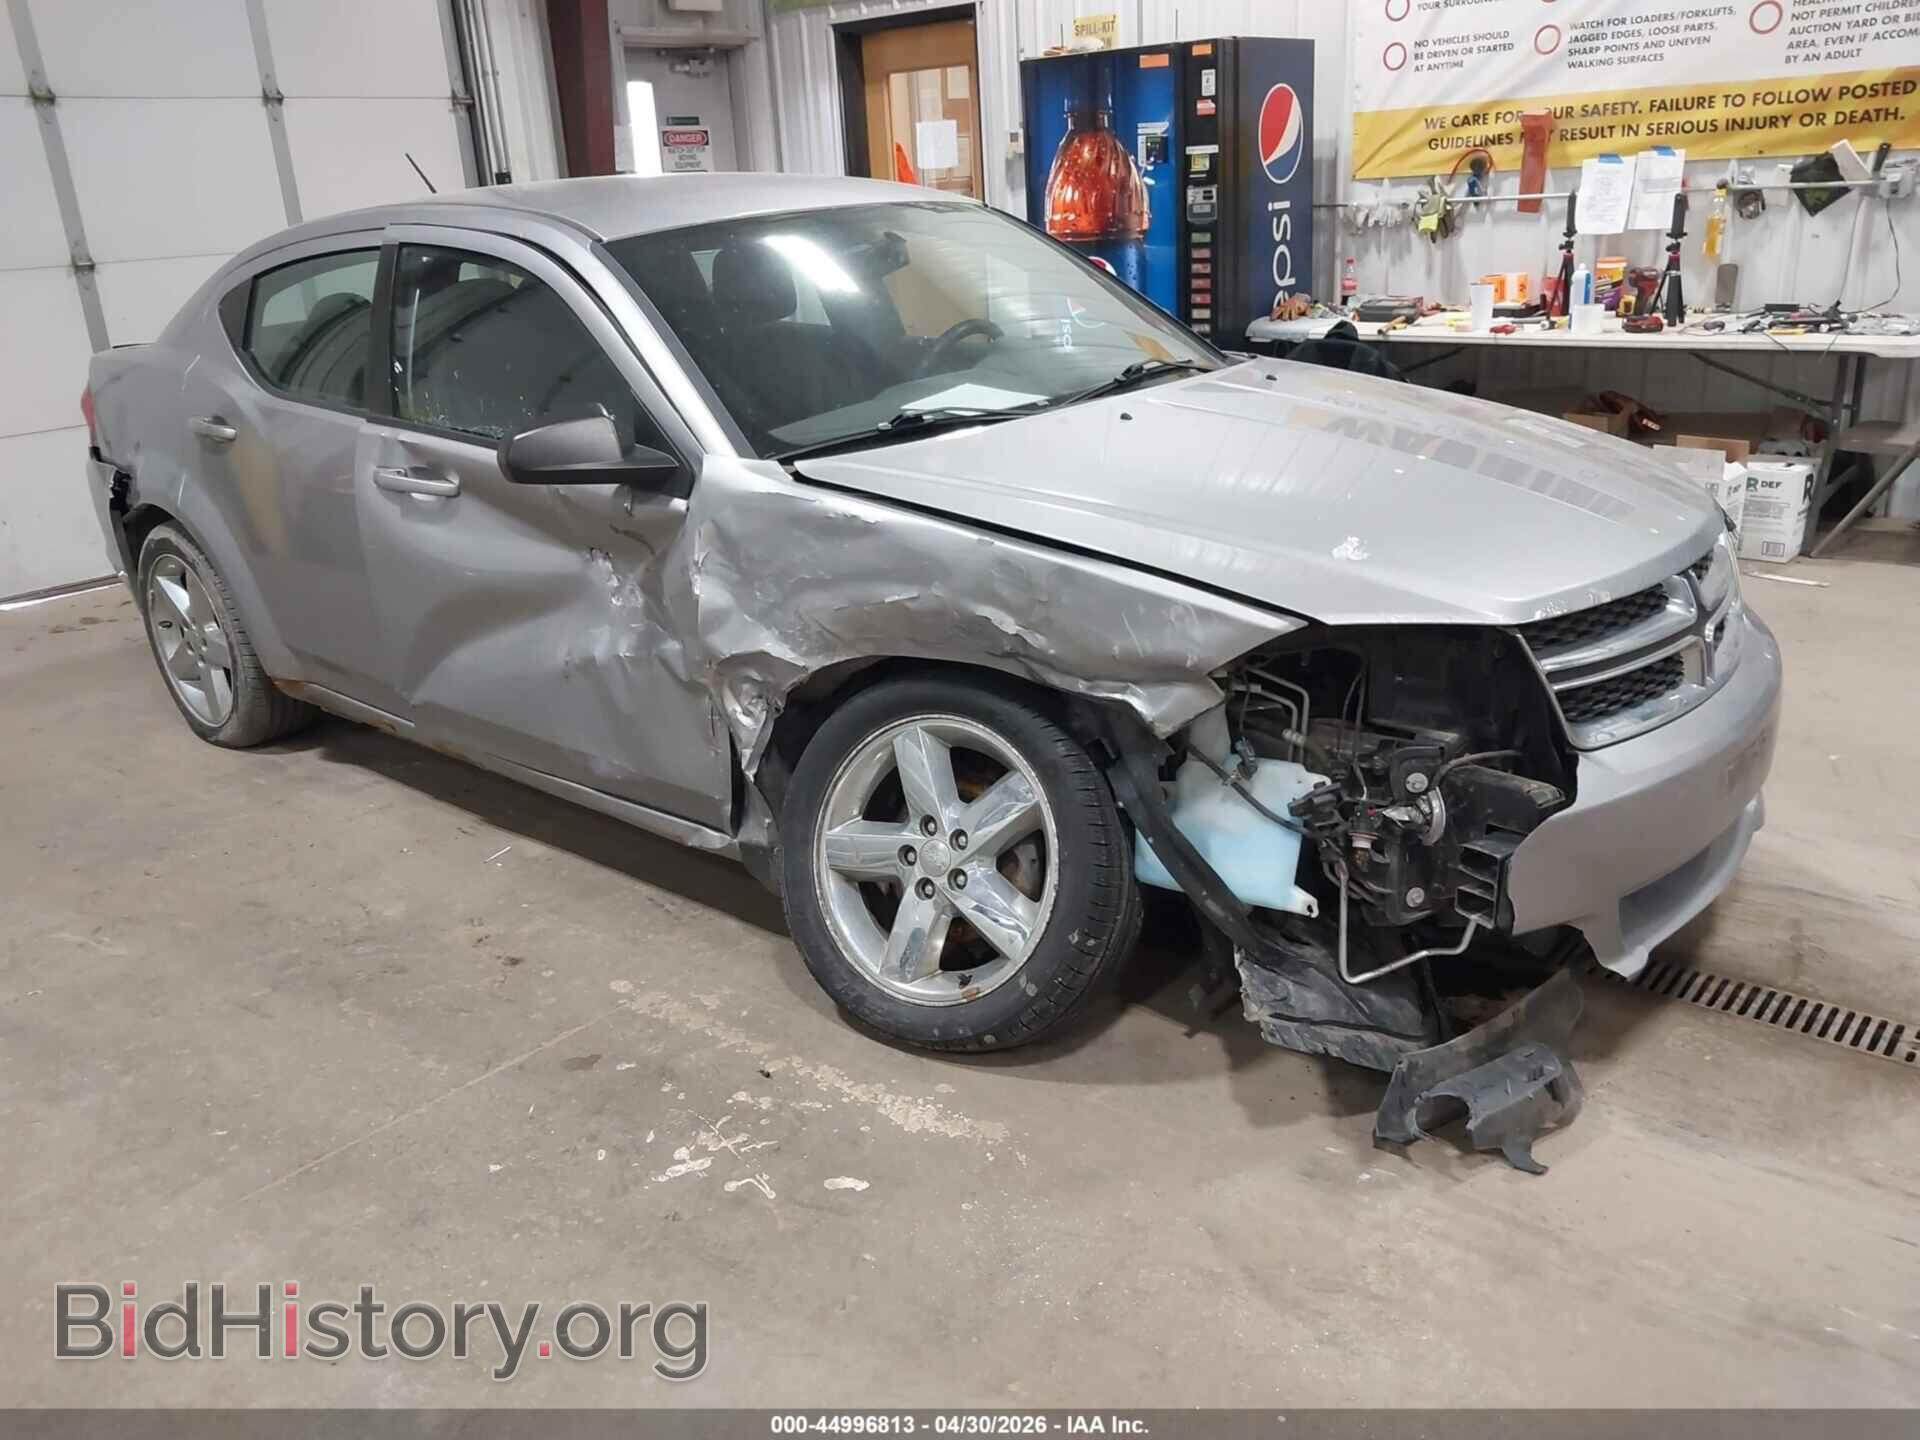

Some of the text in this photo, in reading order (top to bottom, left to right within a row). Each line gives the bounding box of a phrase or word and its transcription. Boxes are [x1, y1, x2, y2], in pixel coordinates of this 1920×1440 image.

[1417, 1, 1441, 11] YOUR
[1791, 11, 1817, 21] NOT
[1819, 5, 1862, 18] PERMIT
[1569, 19, 1604, 31] WATCH
[1607, 15, 1627, 27] FOR
[1788, 23, 1842, 36] AUCTION
[1845, 16, 1878, 30] YARD
[1881, 14, 1901, 26] OR
[1414, 30, 1510, 49] NO VEHICLES SHOULD
[1568, 21, 1718, 44] JAGGED EDGES, LOOSE PARTS,
[1824, 35, 1855, 47] EVEN
[1859, 32, 1870, 43] IF
[1414, 42, 1515, 61] BE DRIVEN OR STARTED
[1567, 35, 1711, 57] SHARP POINTS AND UNEVEN
[1567, 53, 1665, 69] WALKING SURFACES
[1784, 48, 1863, 64] BY AN ADULT
[1414, 60, 1464, 73] AT ANYTIME
[1425, 116, 1447, 130] WE
[1451, 112, 1489, 127] CARE
[1580, 100, 1643, 118] SAFETY.
[1649, 95, 1716, 113] FAILURE
[1722, 93, 1746, 109] TO
[1752, 87, 1832, 107] FOLLOW
[1838, 80, 1918, 101] POSTED
[1428, 132, 1514, 151] GUIDELINES
[1560, 125, 1616, 142] RESULT
[1621, 123, 1640, 138] IN
[1645, 118, 1719, 136] SERIOUS
[1725, 113, 1793, 132] INJURY
[1799, 112, 1827, 127] OR
[1834, 107, 1906, 126] DEATH.
[1761, 480, 1783, 489] DEF
